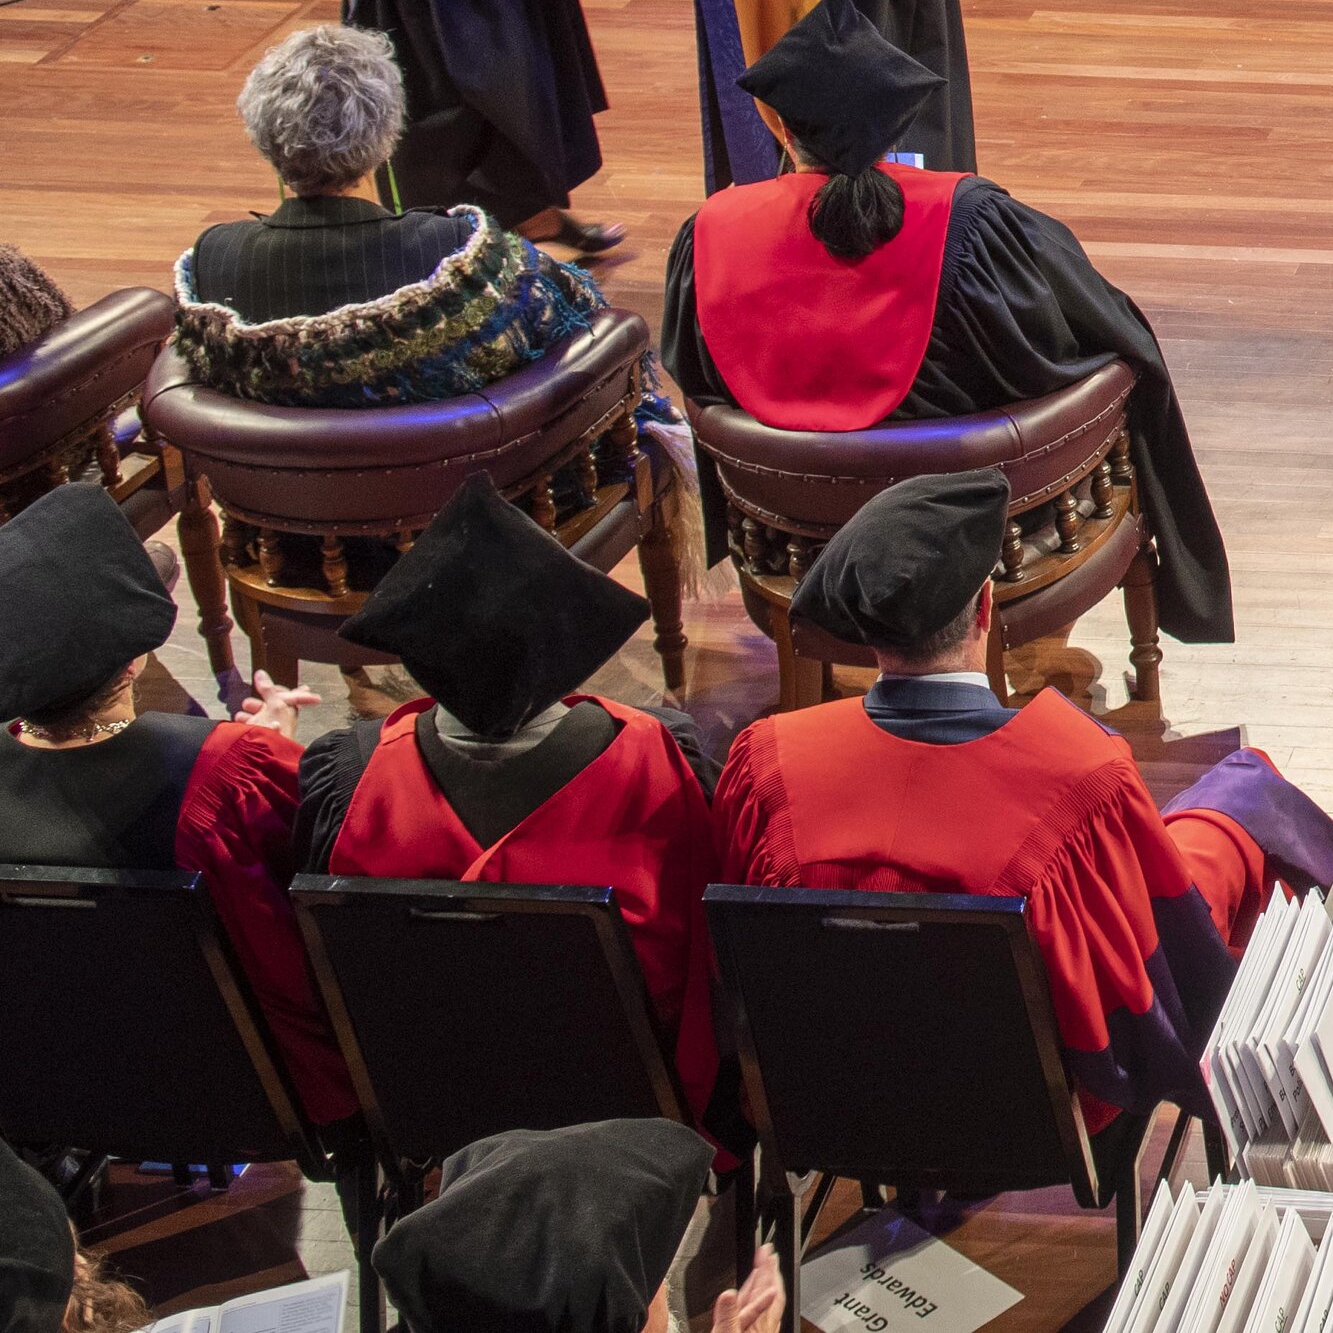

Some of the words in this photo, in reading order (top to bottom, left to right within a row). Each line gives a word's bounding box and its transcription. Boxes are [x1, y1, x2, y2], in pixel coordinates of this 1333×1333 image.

[859, 1262, 938, 1318] Edwards
[1226, 1259, 1236, 1286] CAP
[834, 1292, 889, 1333] Grant
